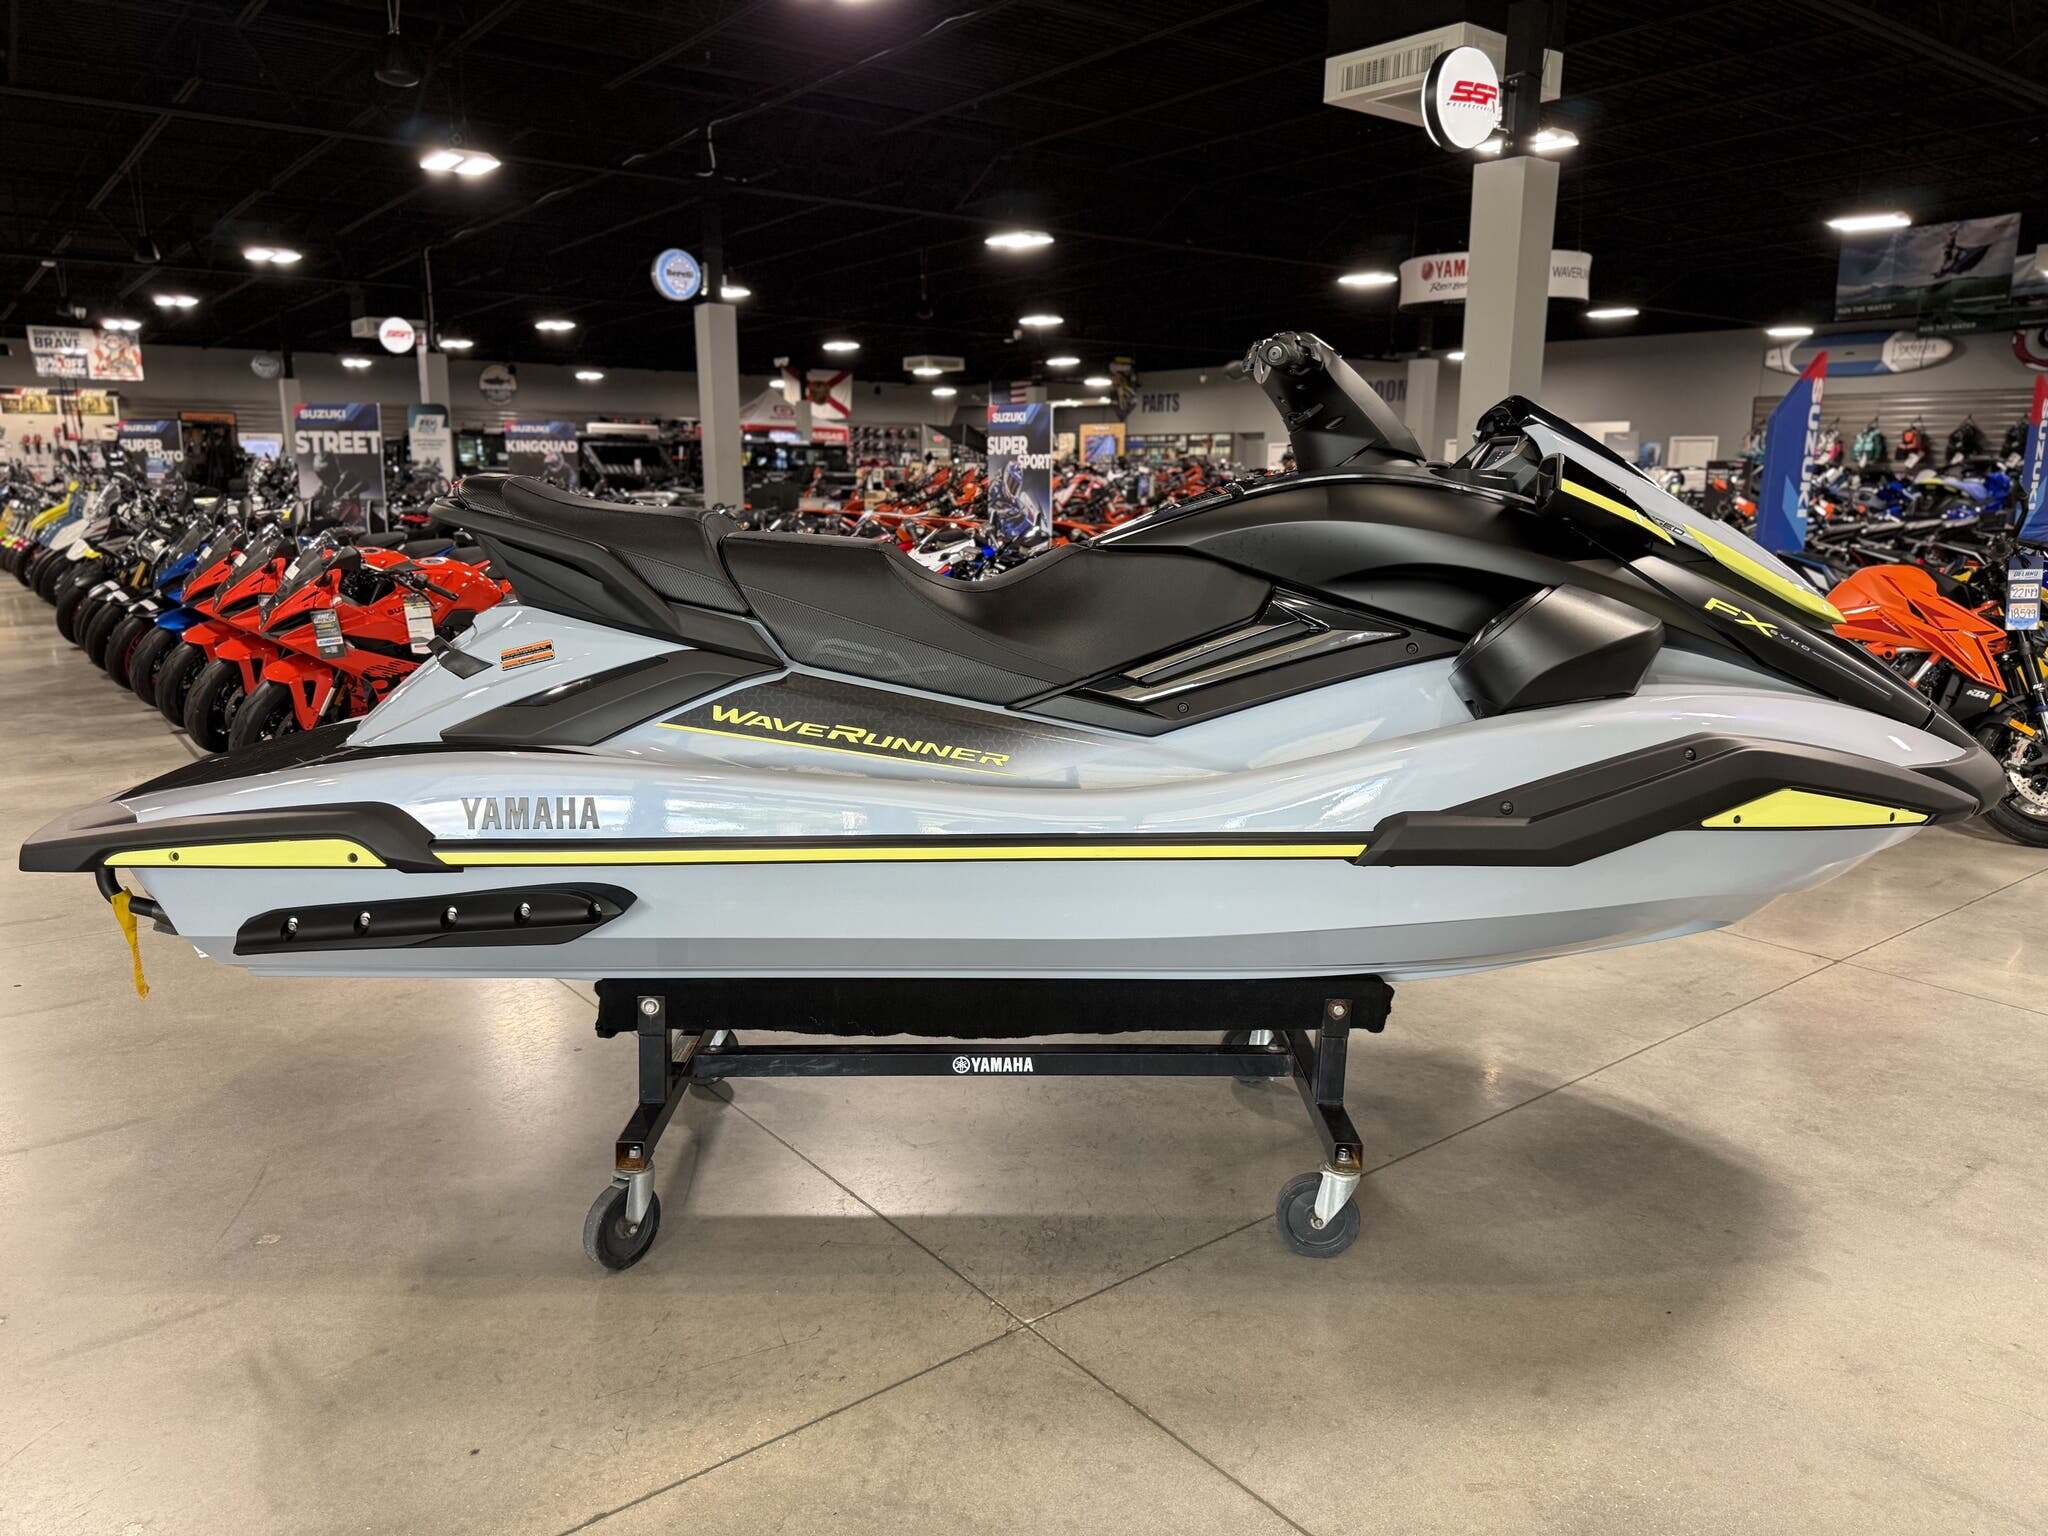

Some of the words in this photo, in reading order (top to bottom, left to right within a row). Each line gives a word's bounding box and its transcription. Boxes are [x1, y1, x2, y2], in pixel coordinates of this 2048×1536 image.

[1435, 259, 1470, 279] YAM
[1142, 393, 1180, 413] PARTS
[300, 408, 347, 420] SUZUKI
[992, 412, 1026, 423] SUZUKI
[119, 438, 162, 452] SUPER
[295, 430, 381, 454] STREET
[506, 440, 578, 453] KINGQUAD
[987, 435, 1028, 456] SUPER
[1017, 453, 1051, 470] SPORT
[1704, 597, 1778, 638] FX
[712, 705, 1010, 767] WAVERUNNER
[461, 797, 600, 830] YAMAHA
[971, 1057, 1034, 1072] YAMAHA
